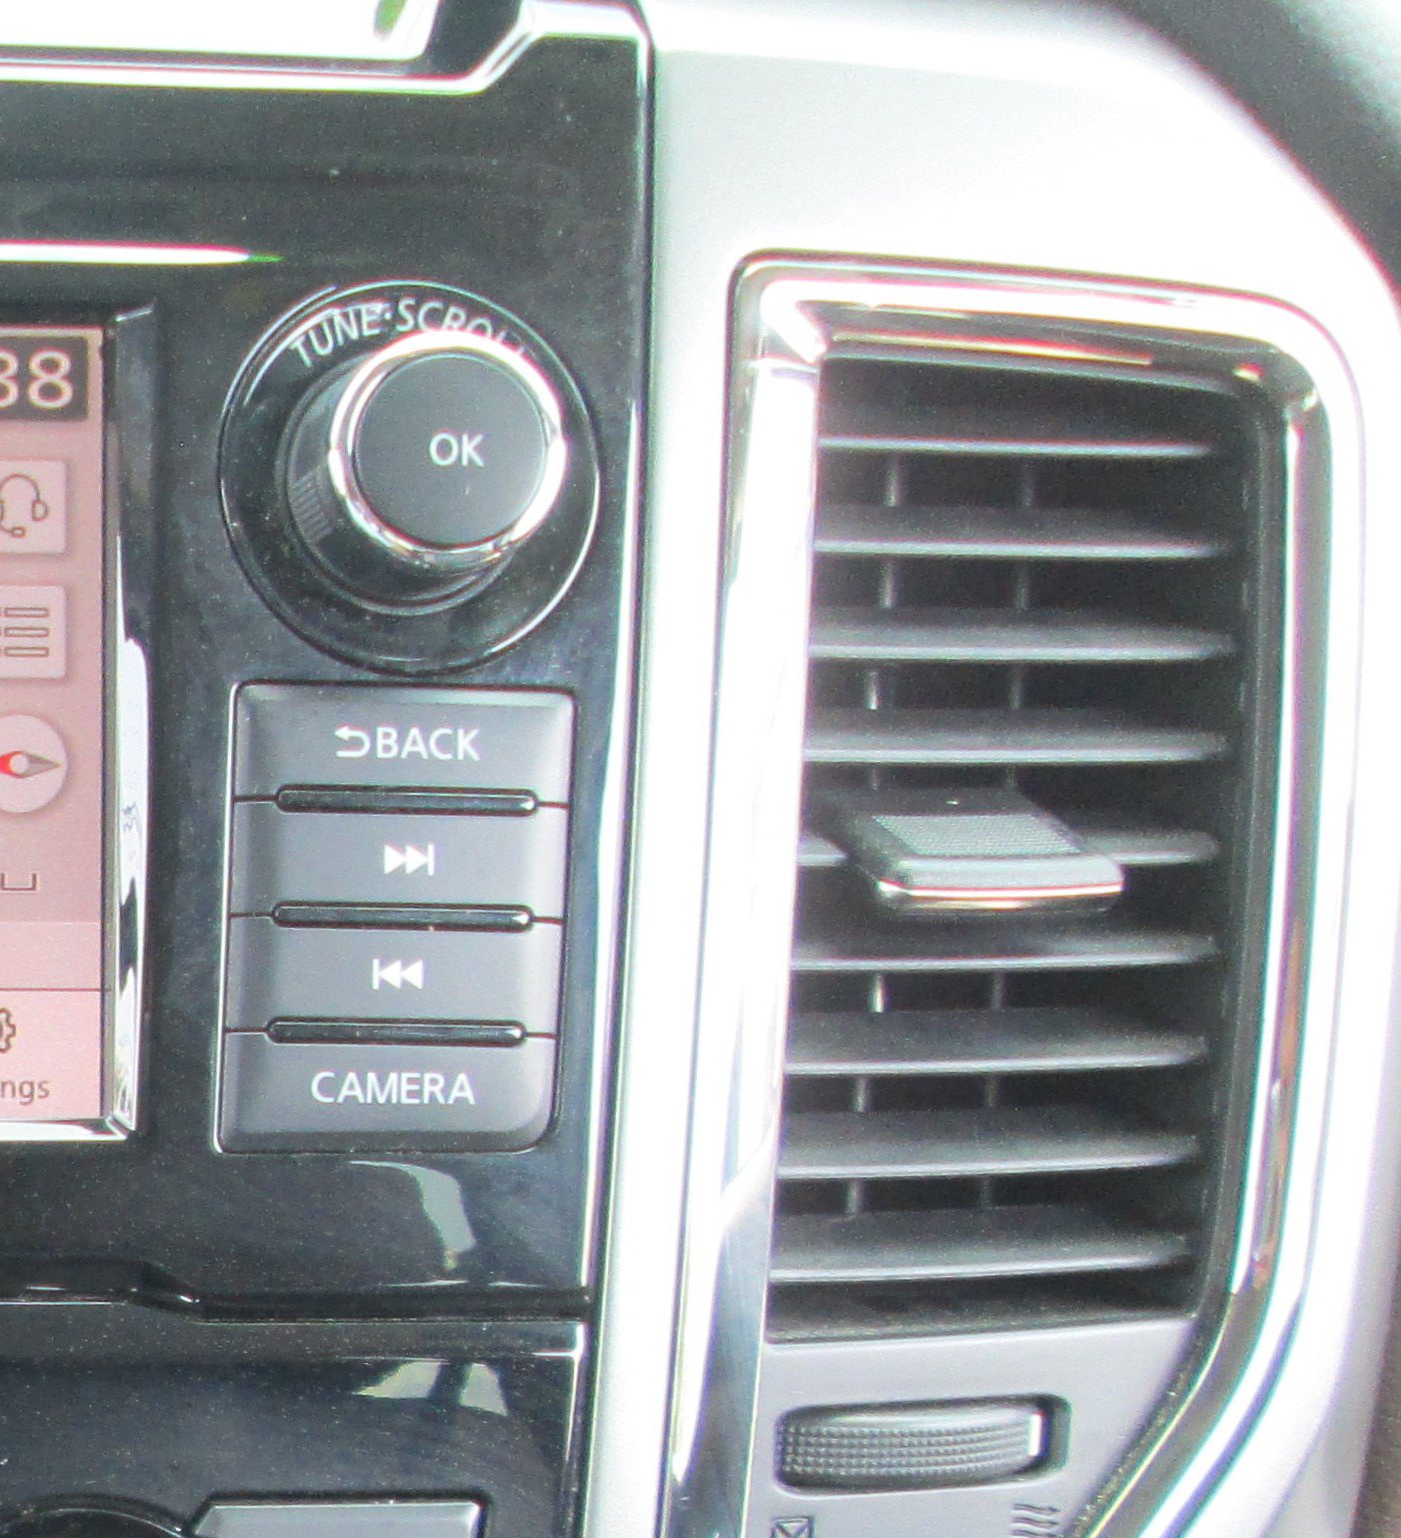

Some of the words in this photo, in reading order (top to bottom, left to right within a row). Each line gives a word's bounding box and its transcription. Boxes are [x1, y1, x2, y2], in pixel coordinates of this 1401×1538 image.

[429, 433, 485, 467] OK
[377, 727, 480, 761] BACK
[311, 1072, 475, 1106] CAMERA
